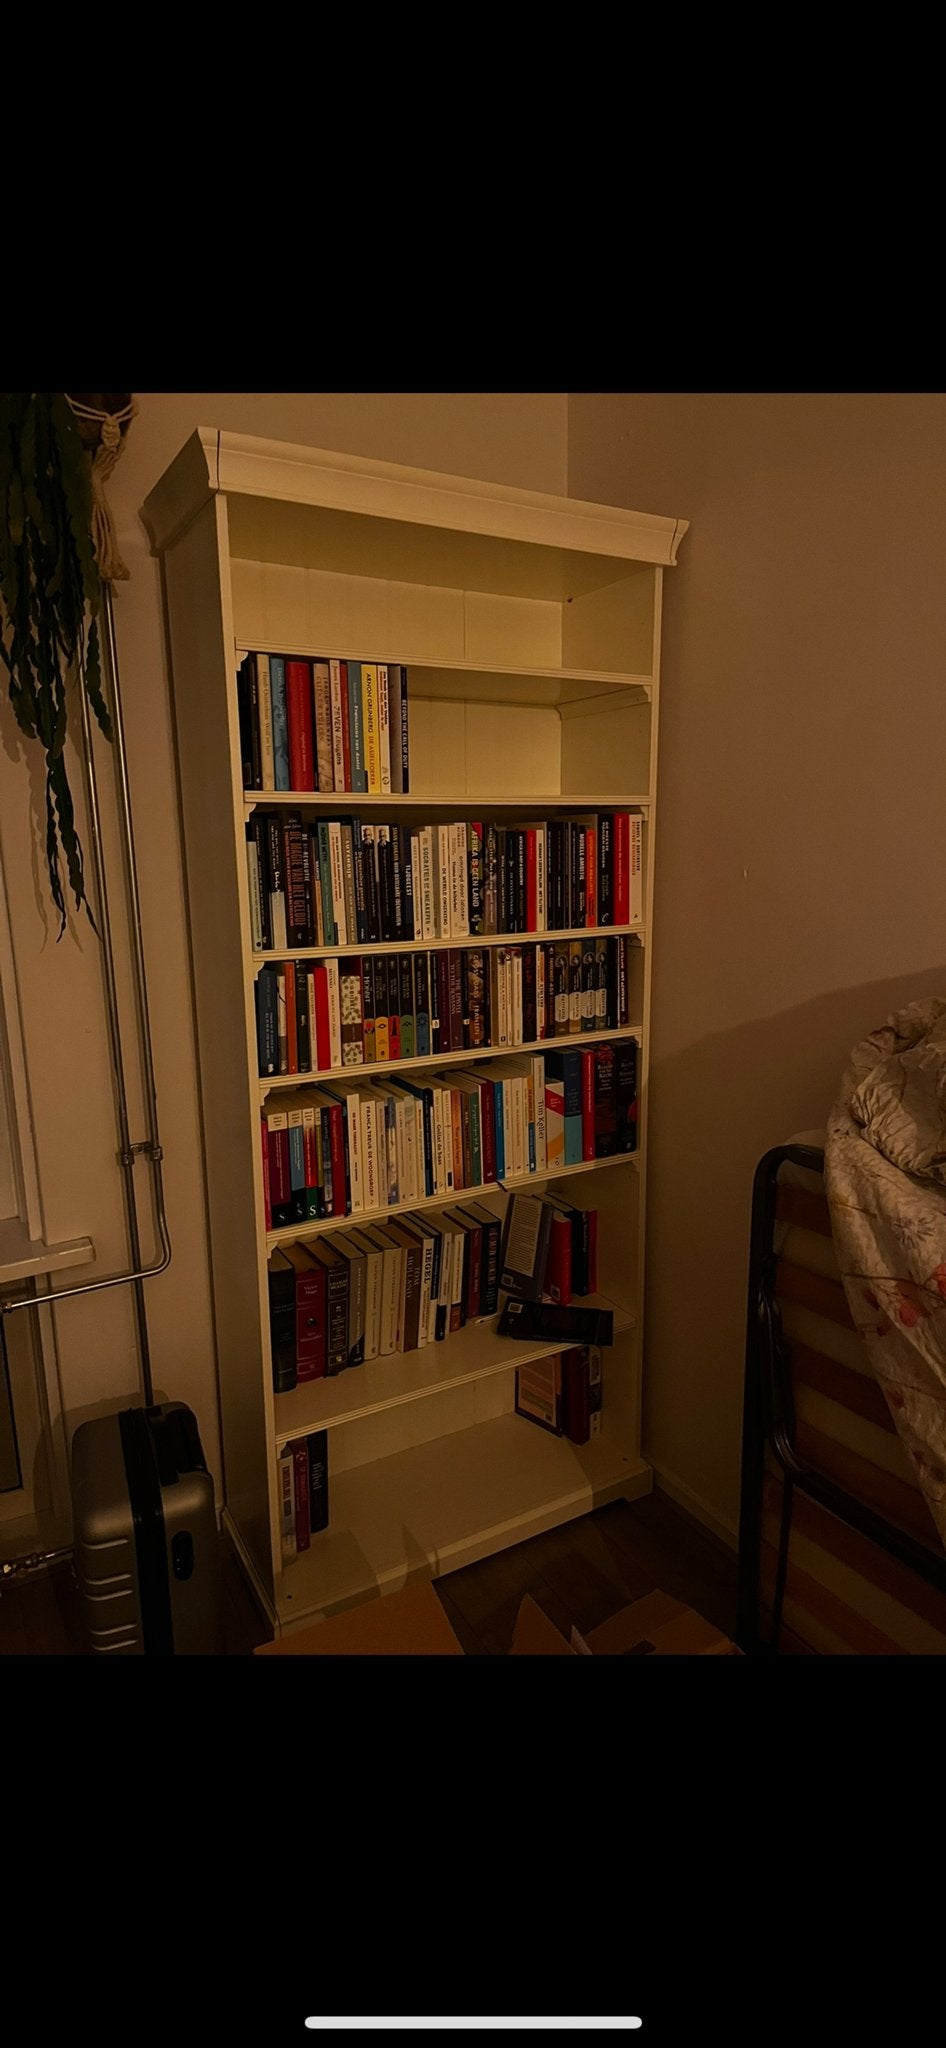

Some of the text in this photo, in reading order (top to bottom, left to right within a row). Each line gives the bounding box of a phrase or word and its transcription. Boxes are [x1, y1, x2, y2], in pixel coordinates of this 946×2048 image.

[368, 736, 374, 745] DE
[290, 832, 306, 926] DE MAGIE VAN HET GELOOF
[536, 1117, 545, 1140] Keller
[310, 1205, 317, 1216] S
[488, 1228, 497, 1256] HERMAN
[424, 1248, 432, 1283] HEGEL
